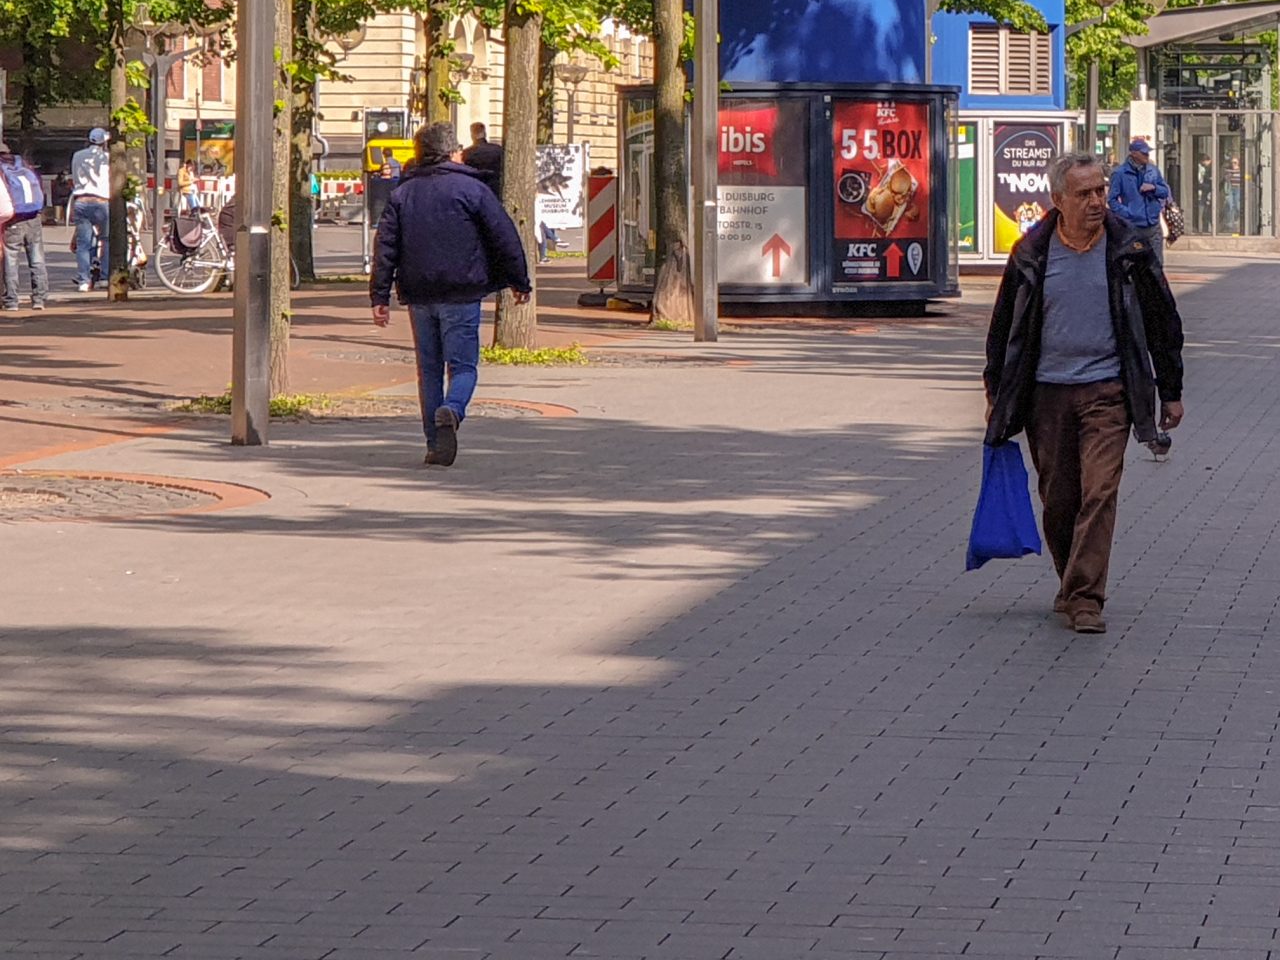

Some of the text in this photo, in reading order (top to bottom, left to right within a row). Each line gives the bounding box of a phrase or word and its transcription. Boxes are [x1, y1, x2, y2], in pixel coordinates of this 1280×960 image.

[876, 108, 897, 118] KFC
[721, 126, 766, 153] ibis
[882, 129, 922, 160] BOX
[1003, 147, 1052, 159] STREAMST
[725, 192, 776, 201] DUISBURG
[717, 205, 769, 215] BAHNHOF
[847, 243, 877, 257] KFC
